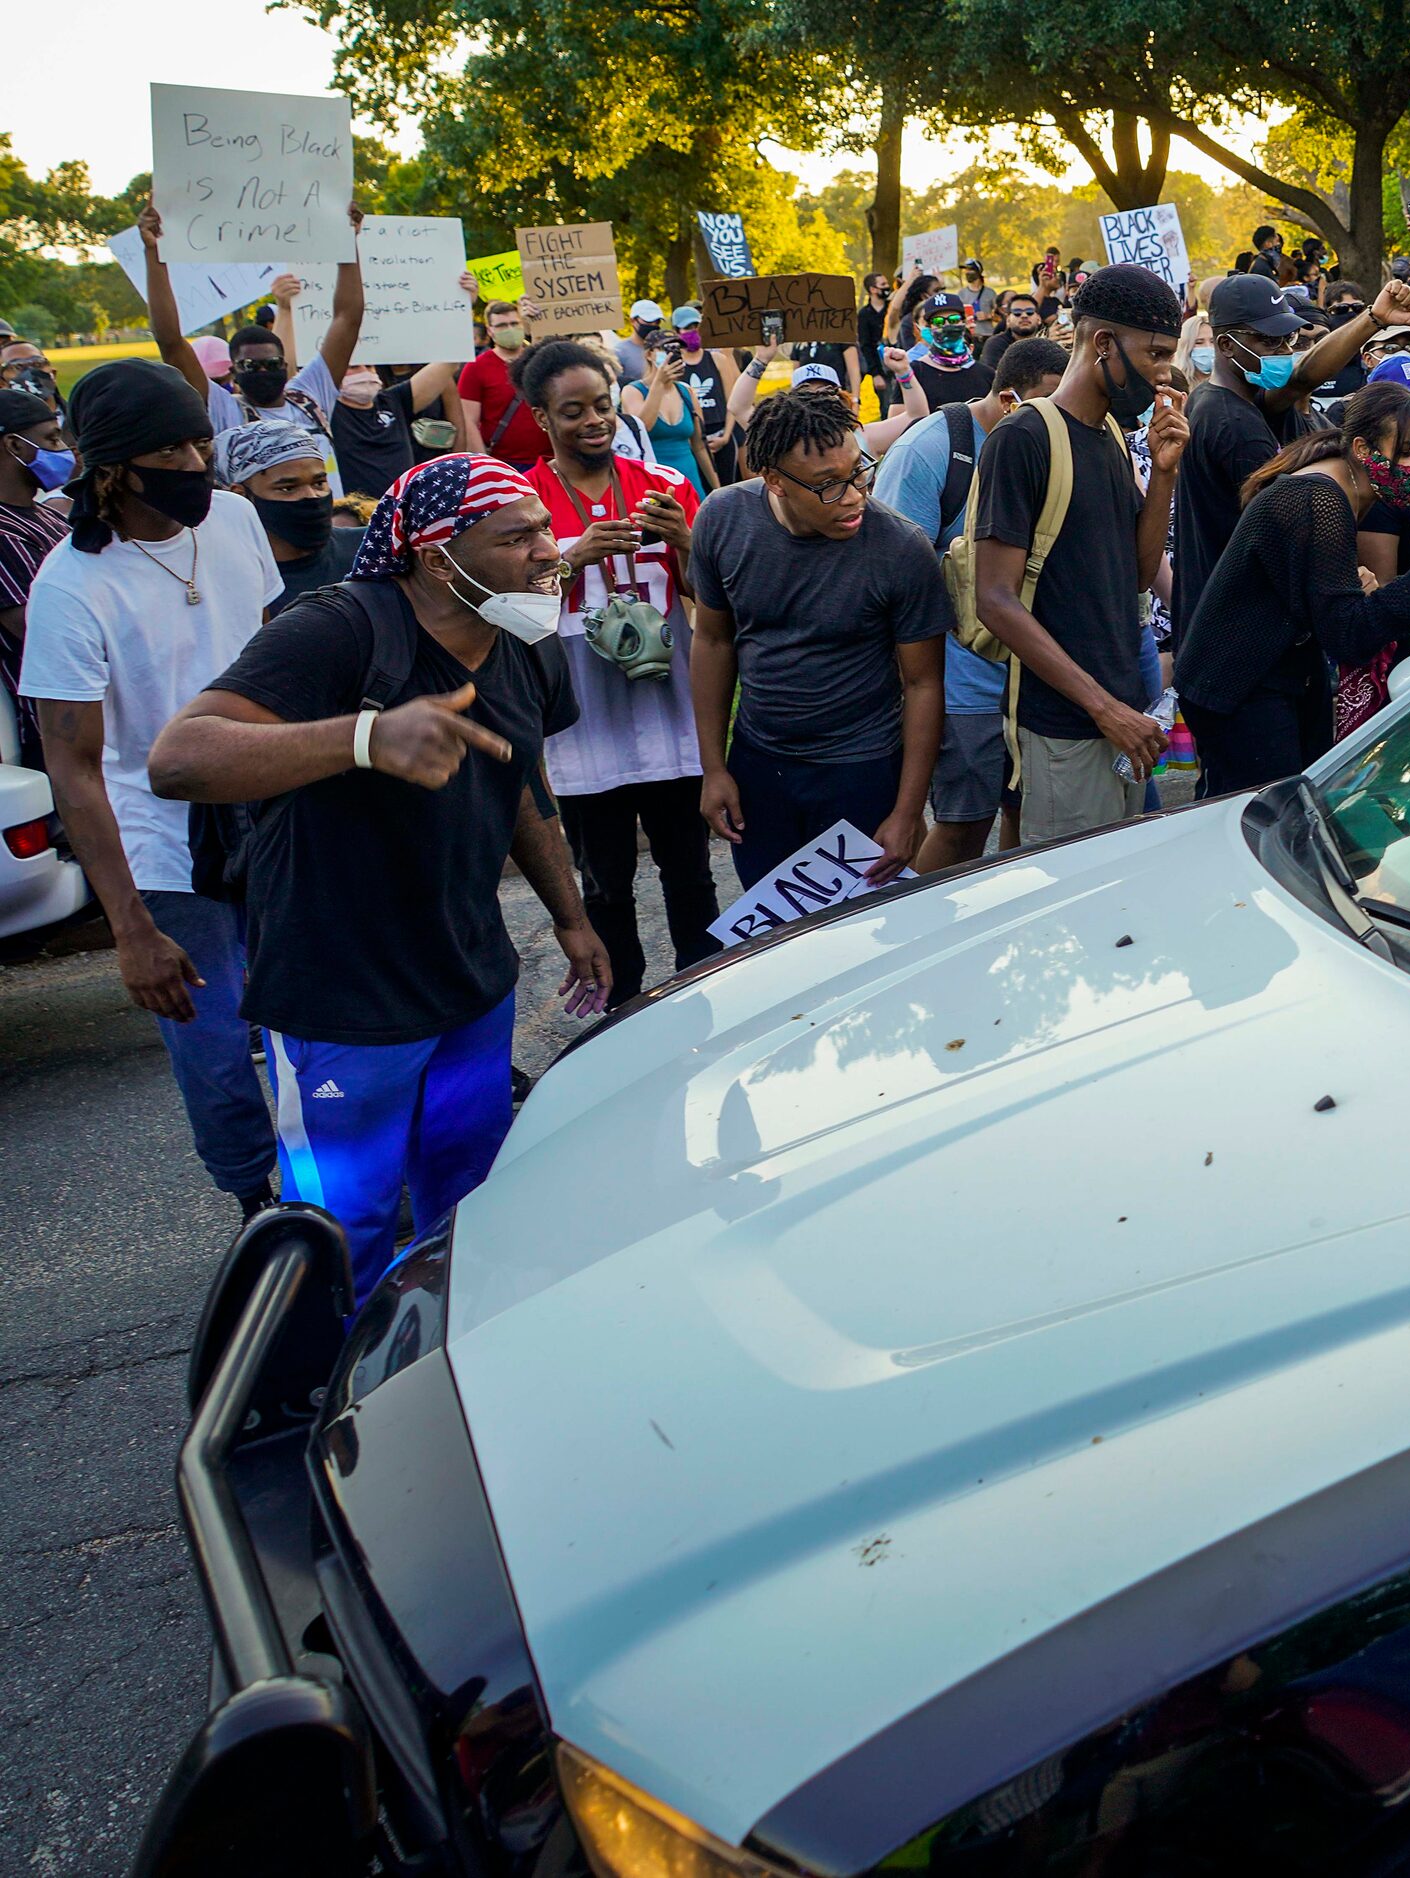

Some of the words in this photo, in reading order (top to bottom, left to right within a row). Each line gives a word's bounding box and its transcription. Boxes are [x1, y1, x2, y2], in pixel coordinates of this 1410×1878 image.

[183, 113, 262, 162] Being
[280, 124, 343, 160] Black
[186, 173, 213, 202] is
[303, 179, 321, 208] A
[698, 211, 742, 229] NOW
[1103, 210, 1156, 242] BLACK
[525, 230, 584, 255] FIGHT
[706, 226, 744, 244] YOU
[1108, 233, 1164, 265] LIVES
[537, 252, 577, 273] THE
[710, 242, 746, 261] SEE
[533, 271, 605, 299] SYSTEM
[709, 277, 837, 317] BLACK
[298, 303, 333, 321] This
[707, 310, 763, 338] LIVE
[782, 307, 856, 331] MATTER
[729, 833, 885, 940] BLACK
[312, 1091, 344, 1099] adidas
